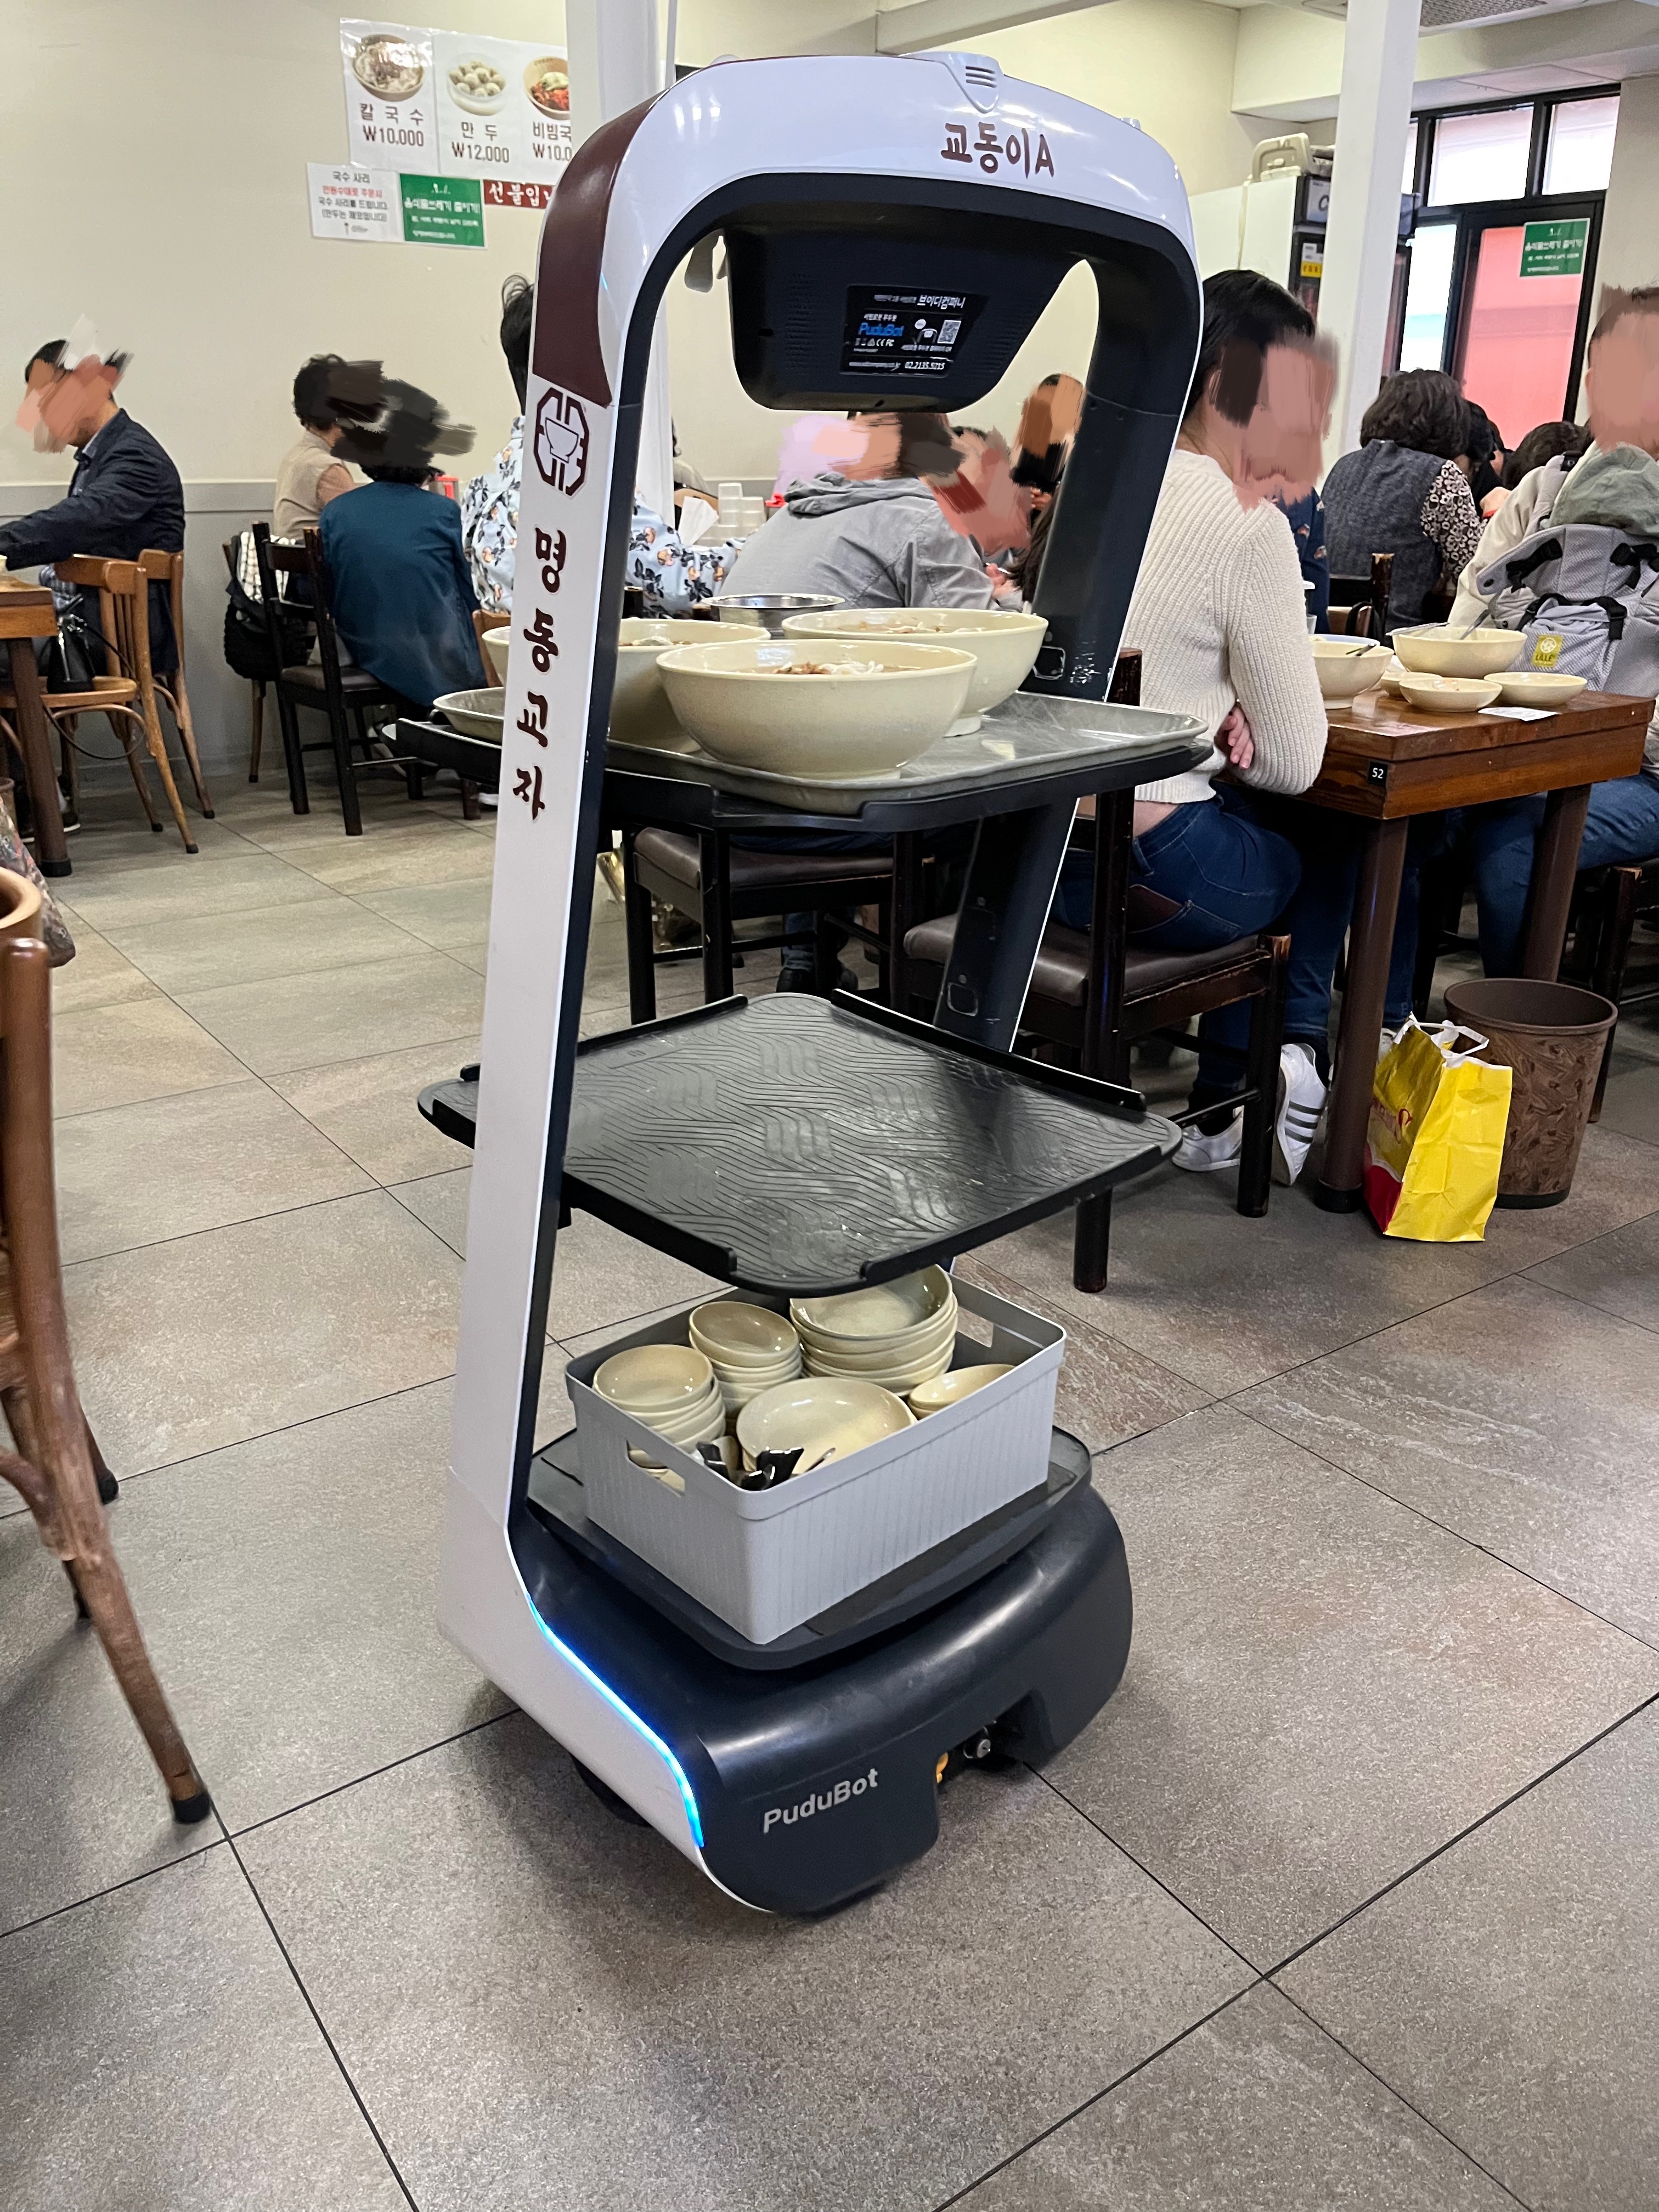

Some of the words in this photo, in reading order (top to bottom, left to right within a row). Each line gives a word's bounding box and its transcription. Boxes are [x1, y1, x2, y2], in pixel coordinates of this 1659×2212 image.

[360, 103, 424, 126] 칼국수
[461, 122, 498, 141] 만두
[941, 121, 1054, 179] 교동이A
[512, 527, 567, 821] 명동교자
[1372, 767, 1384, 779] 52
[763, 1768, 878, 1834] PuduBot
